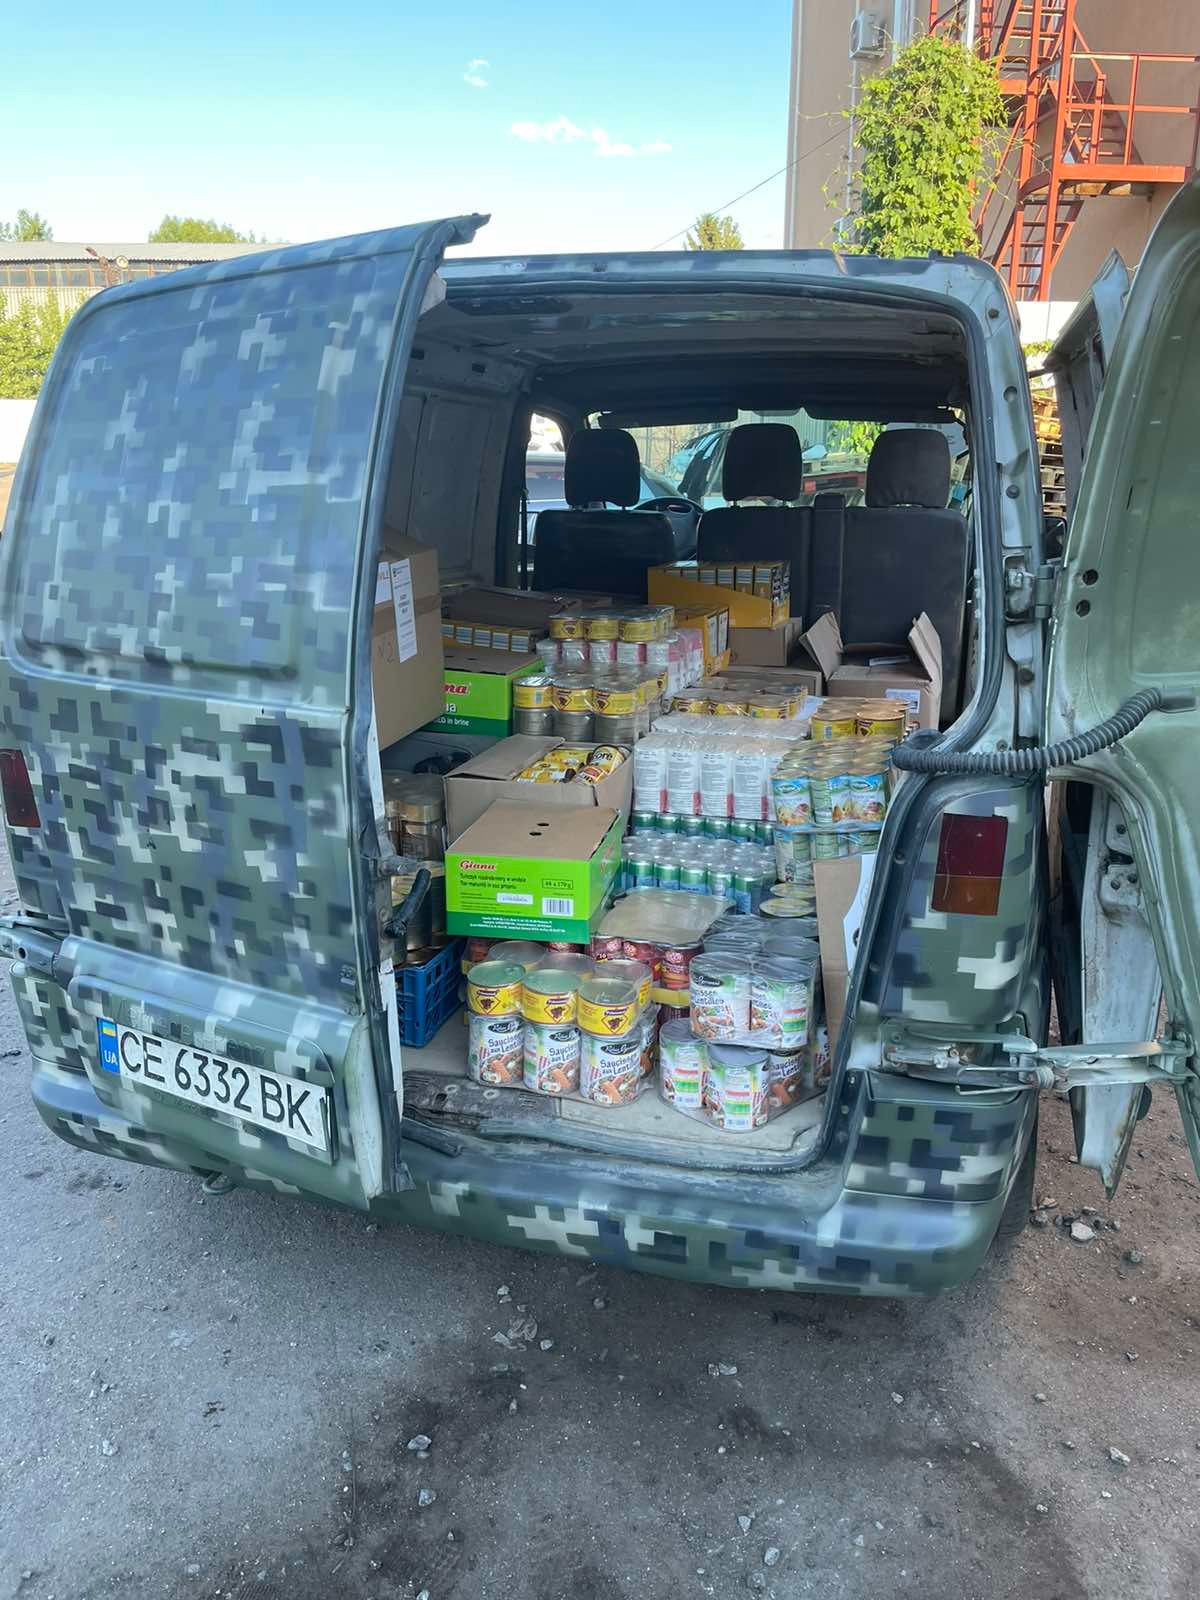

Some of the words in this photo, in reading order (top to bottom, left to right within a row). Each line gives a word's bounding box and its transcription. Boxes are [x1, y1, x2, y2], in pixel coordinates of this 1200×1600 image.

[460, 860, 496, 870] Giana
[103, 1049, 119, 1066] UA
[120, 1030, 165, 1083] CE
[174, 1048, 252, 1114] 6332
[260, 1074, 313, 1137] BK
